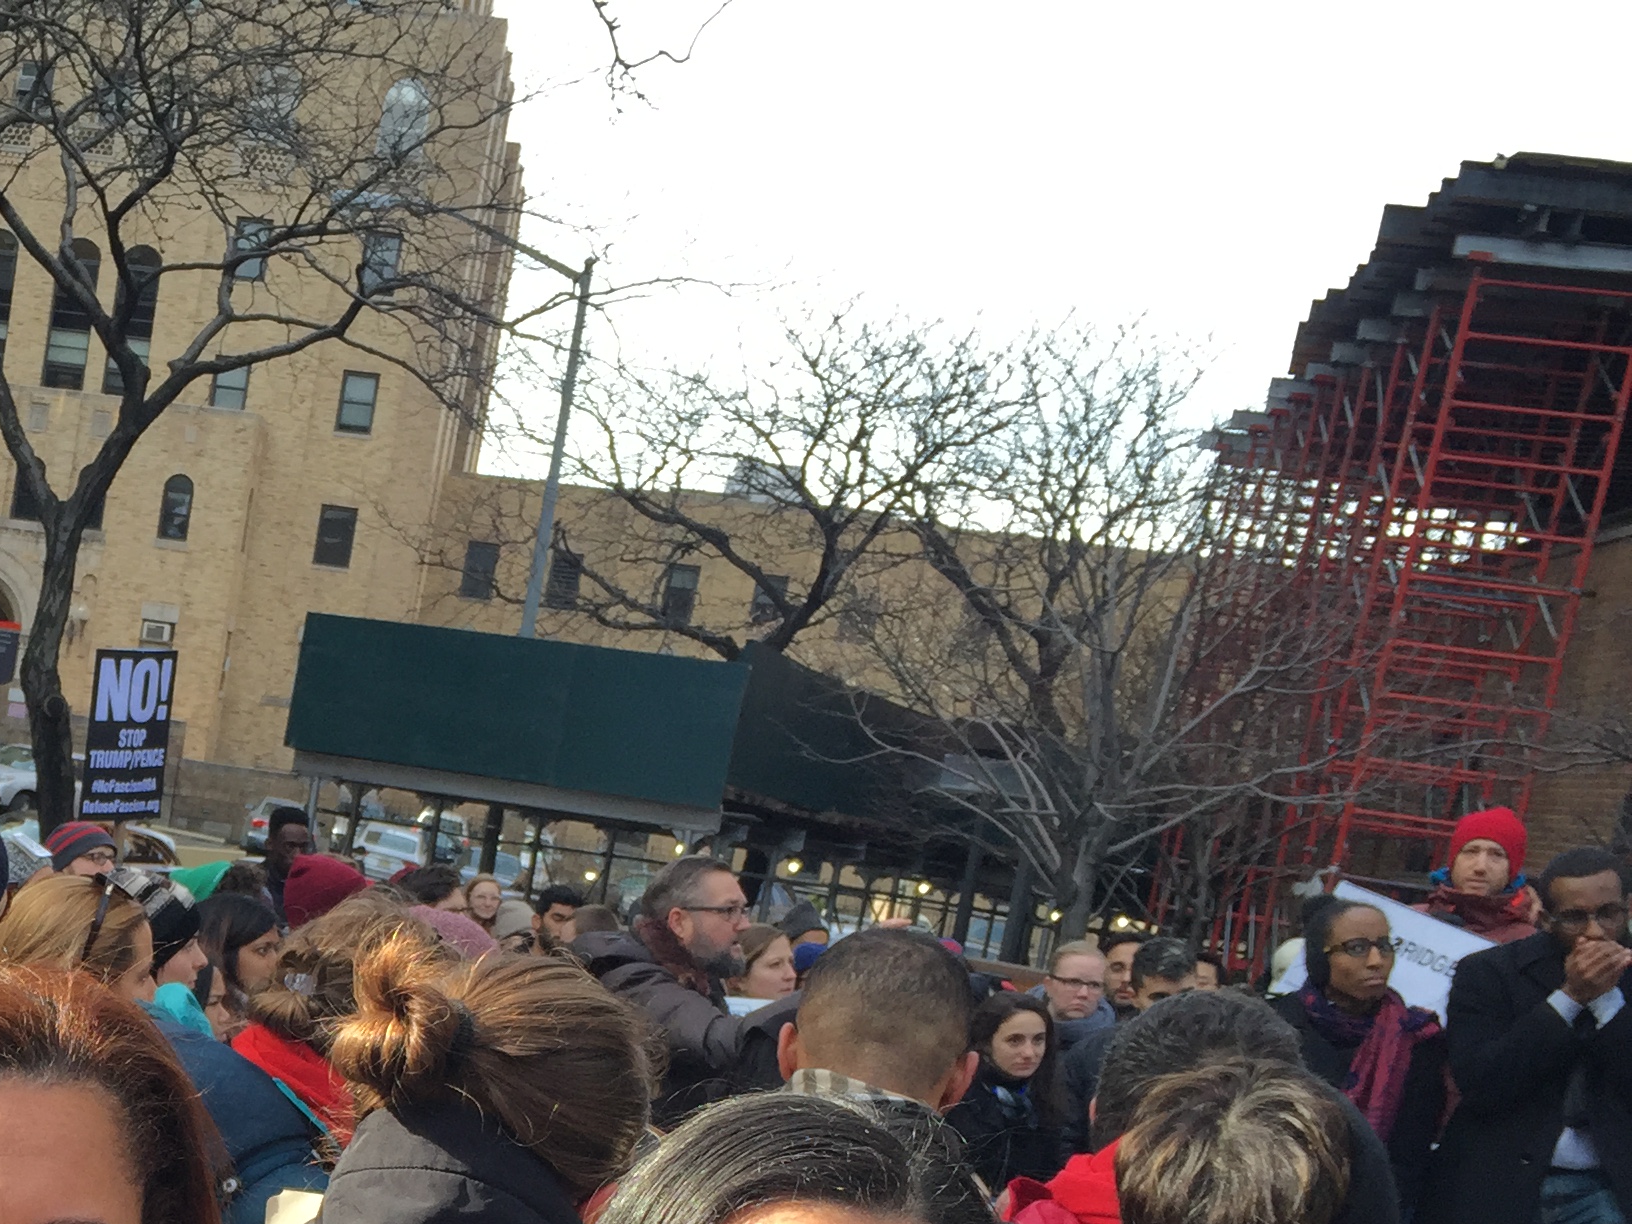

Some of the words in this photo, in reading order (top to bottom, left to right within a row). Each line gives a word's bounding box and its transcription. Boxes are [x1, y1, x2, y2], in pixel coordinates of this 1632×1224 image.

[94, 657, 173, 723] NO!
[118, 728, 148, 748] STOP
[89, 748, 166, 770] TRUMP/PENCE
